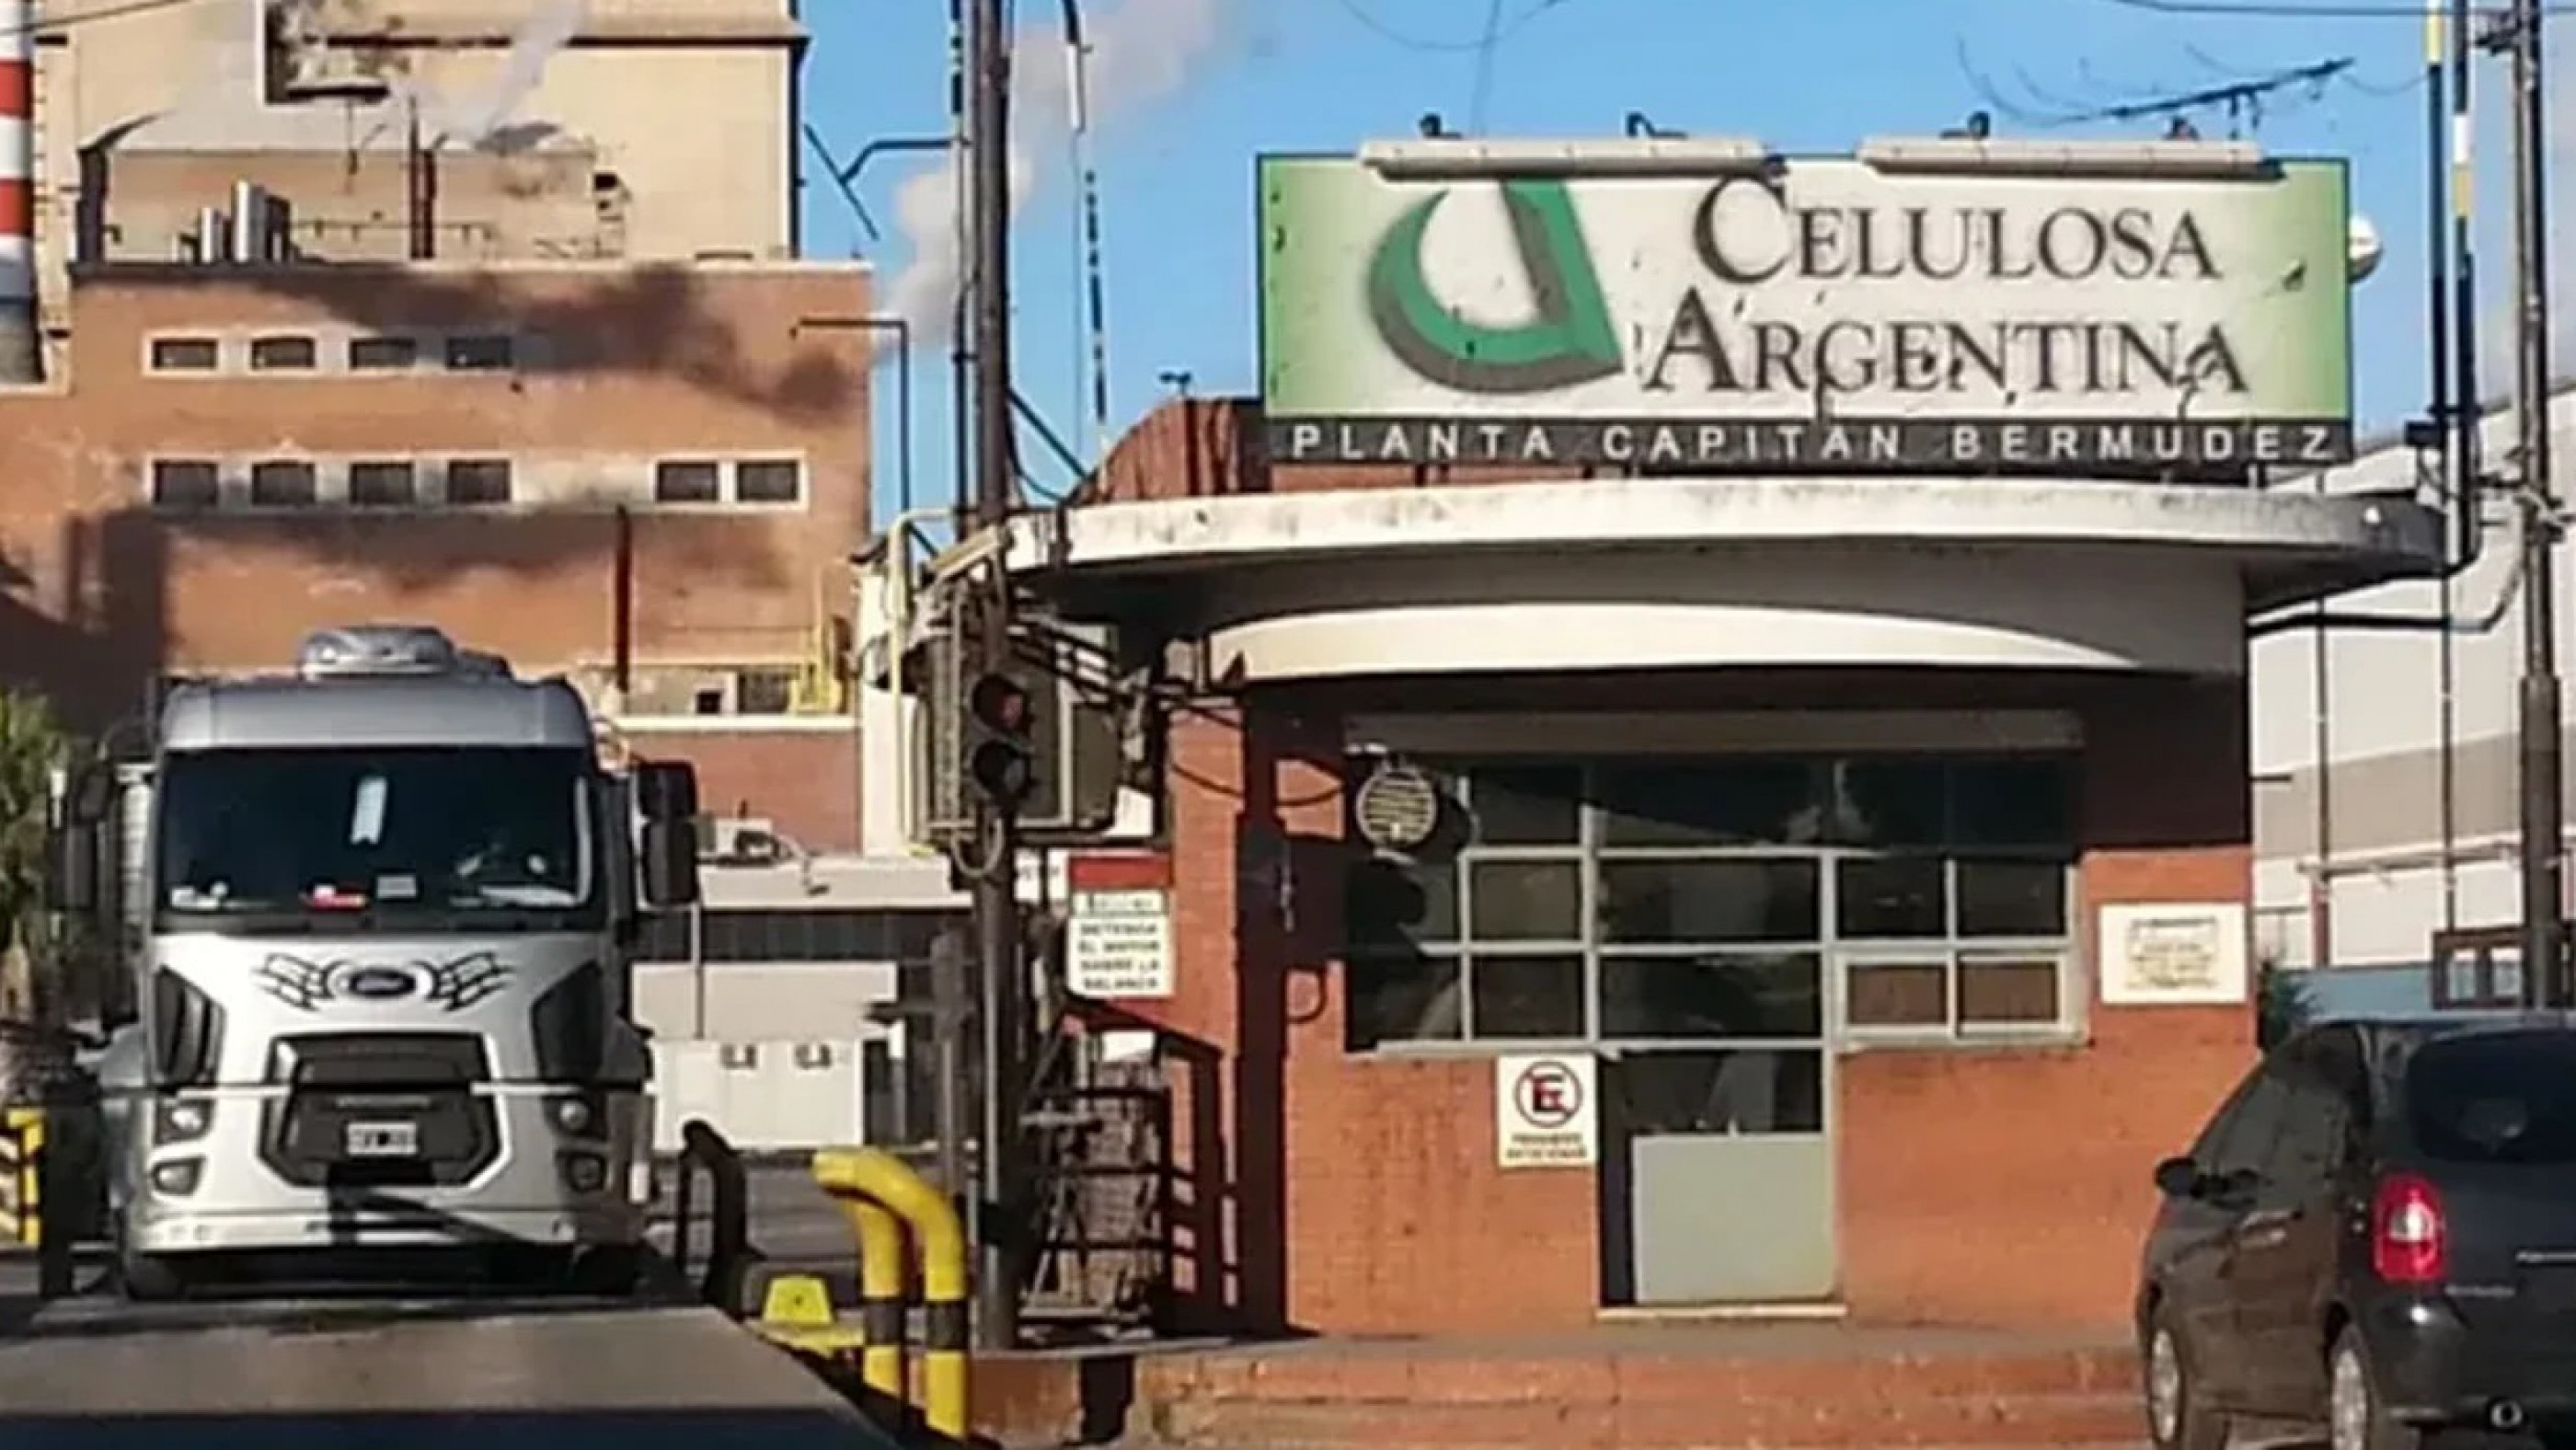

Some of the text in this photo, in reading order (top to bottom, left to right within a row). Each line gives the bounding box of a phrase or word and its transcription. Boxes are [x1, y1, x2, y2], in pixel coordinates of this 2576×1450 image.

[1693, 175, 2224, 285] CELULOSA
[1642, 285, 2250, 395] ARGENTINA
[1292, 423, 2331, 462] PLANTA CAPITAN BERMUDEZ
